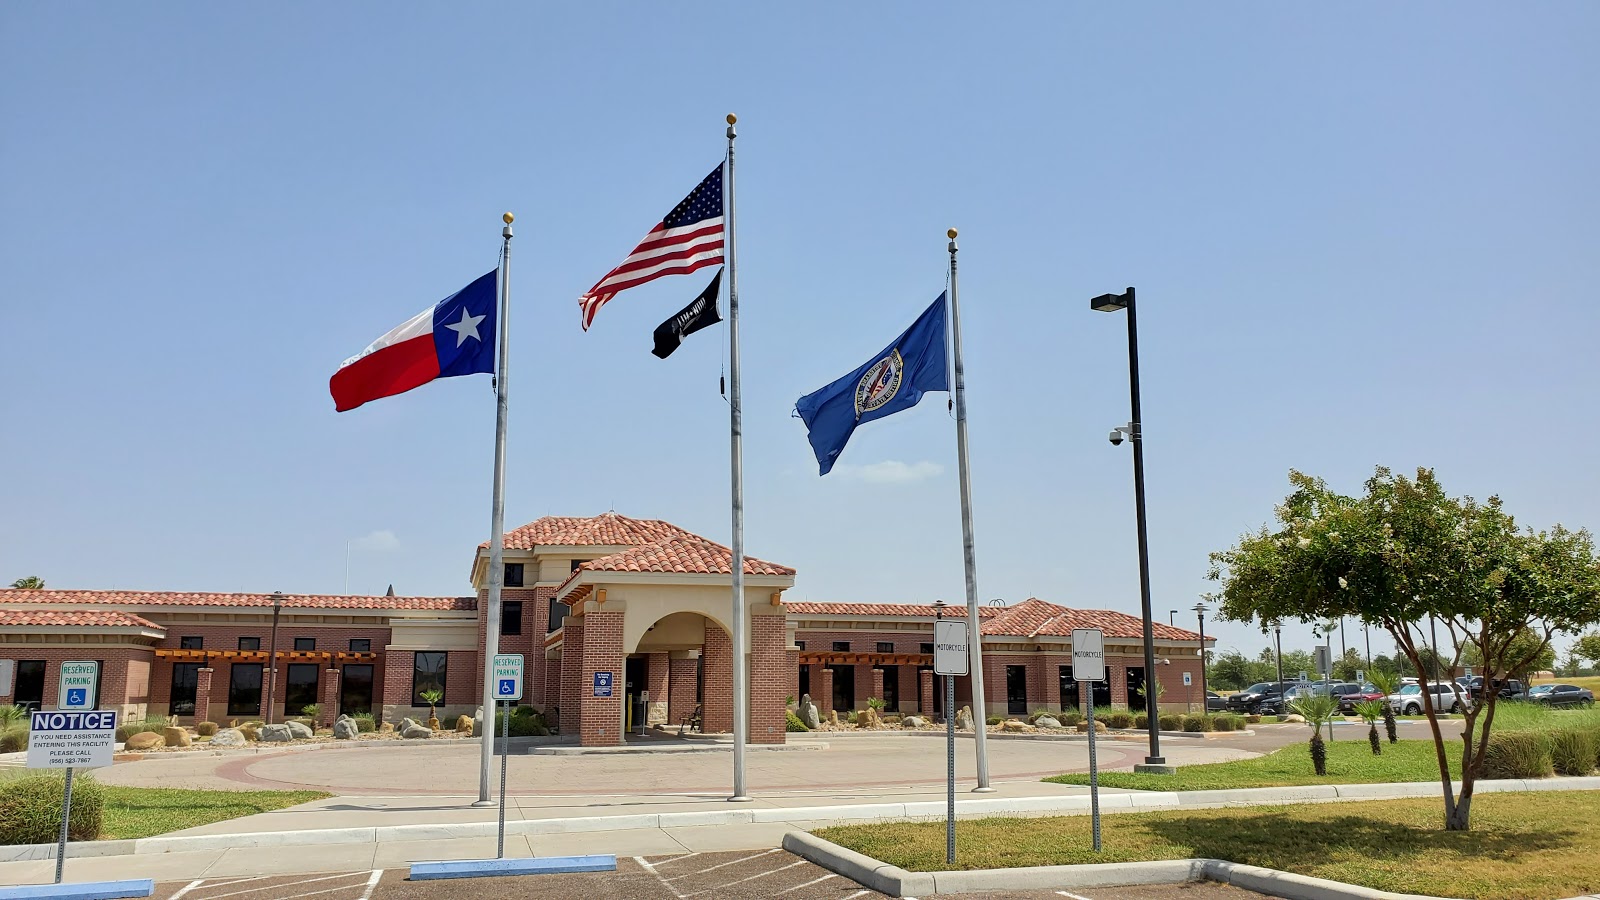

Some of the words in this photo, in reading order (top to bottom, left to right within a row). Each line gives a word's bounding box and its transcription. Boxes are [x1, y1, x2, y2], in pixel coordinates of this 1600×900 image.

[936, 643, 966, 652] MOTORCYCLE
[1074, 650, 1102, 659] MOTORCYCLE
[495, 658, 521, 666] RESERVED
[63, 665, 95, 674] RESERVED
[64, 677, 91, 685] PARKING
[34, 713, 113, 729] NOTICE
